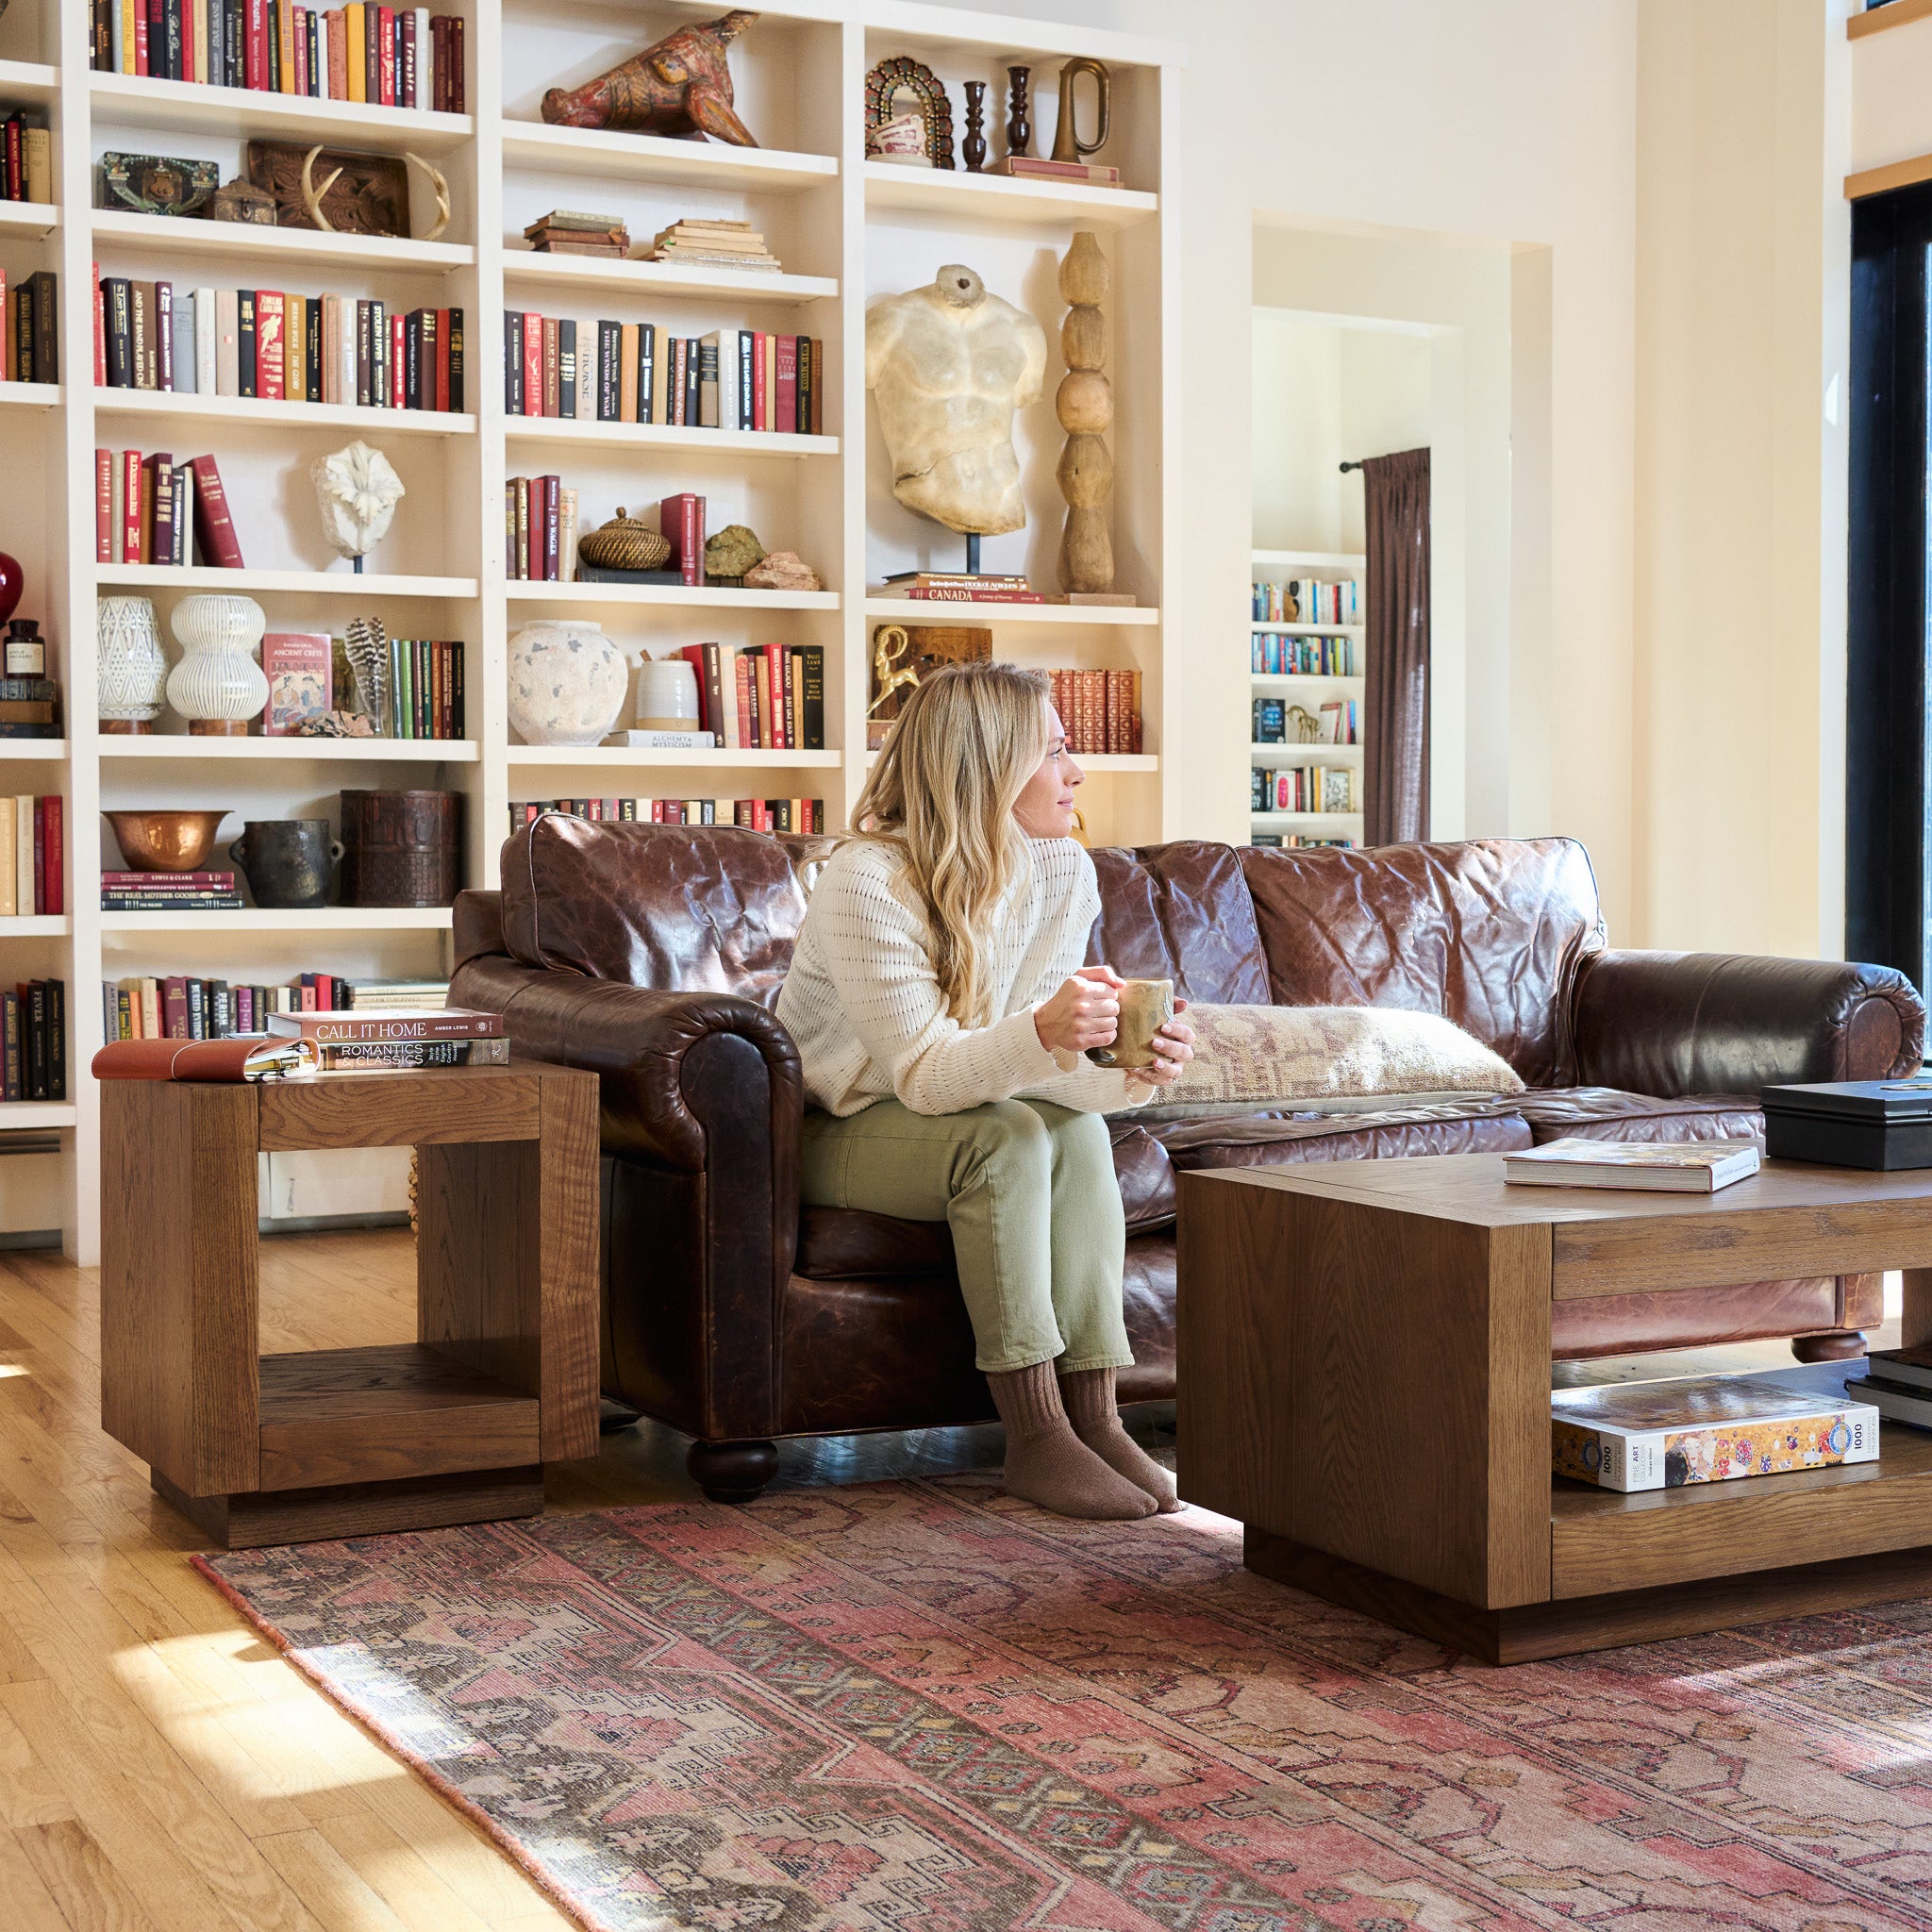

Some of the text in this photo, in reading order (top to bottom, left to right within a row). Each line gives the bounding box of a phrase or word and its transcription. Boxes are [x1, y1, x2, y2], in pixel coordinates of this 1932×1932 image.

[406, 42, 415, 92] Trouble
[135, 290, 143, 308] AND
[135, 309, 143, 325] THE
[291, 301, 300, 349] HERMAN WOUK
[374, 305, 383, 337] STOLEN
[135, 325, 144, 345] BAND
[136, 345, 144, 372] PLAYED
[375, 338, 383, 361] LIVES
[291, 355, 300, 391] THE GLORY
[547, 357, 555, 368] IN
[676, 351, 685, 379] STORM
[582, 354, 594, 400] HORSE
[604, 381, 611, 395] OF
[928, 589, 973, 602] CANADA
[304, 650, 324, 658] CRETE
[773, 648, 782, 693] BILLY GRAHAM
[784, 665, 792, 689] LUCADO
[784, 695, 792, 708] JUST
[624, 802, 632, 822] LAST
[33, 991, 43, 1022] FEVER
[191, 984, 201, 1011] BURIED
[218, 991, 229, 1025] PERISH
[317, 1022, 427, 1040] CALL IT HOME
[341, 1043, 424, 1056] ROMANTICS
[341, 1054, 424, 1067] & CLASSICS
[1854, 1423, 1862, 1450] 1000
[1603, 1445, 1612, 1474] 1000
[1632, 1464, 1641, 1484] FINE
